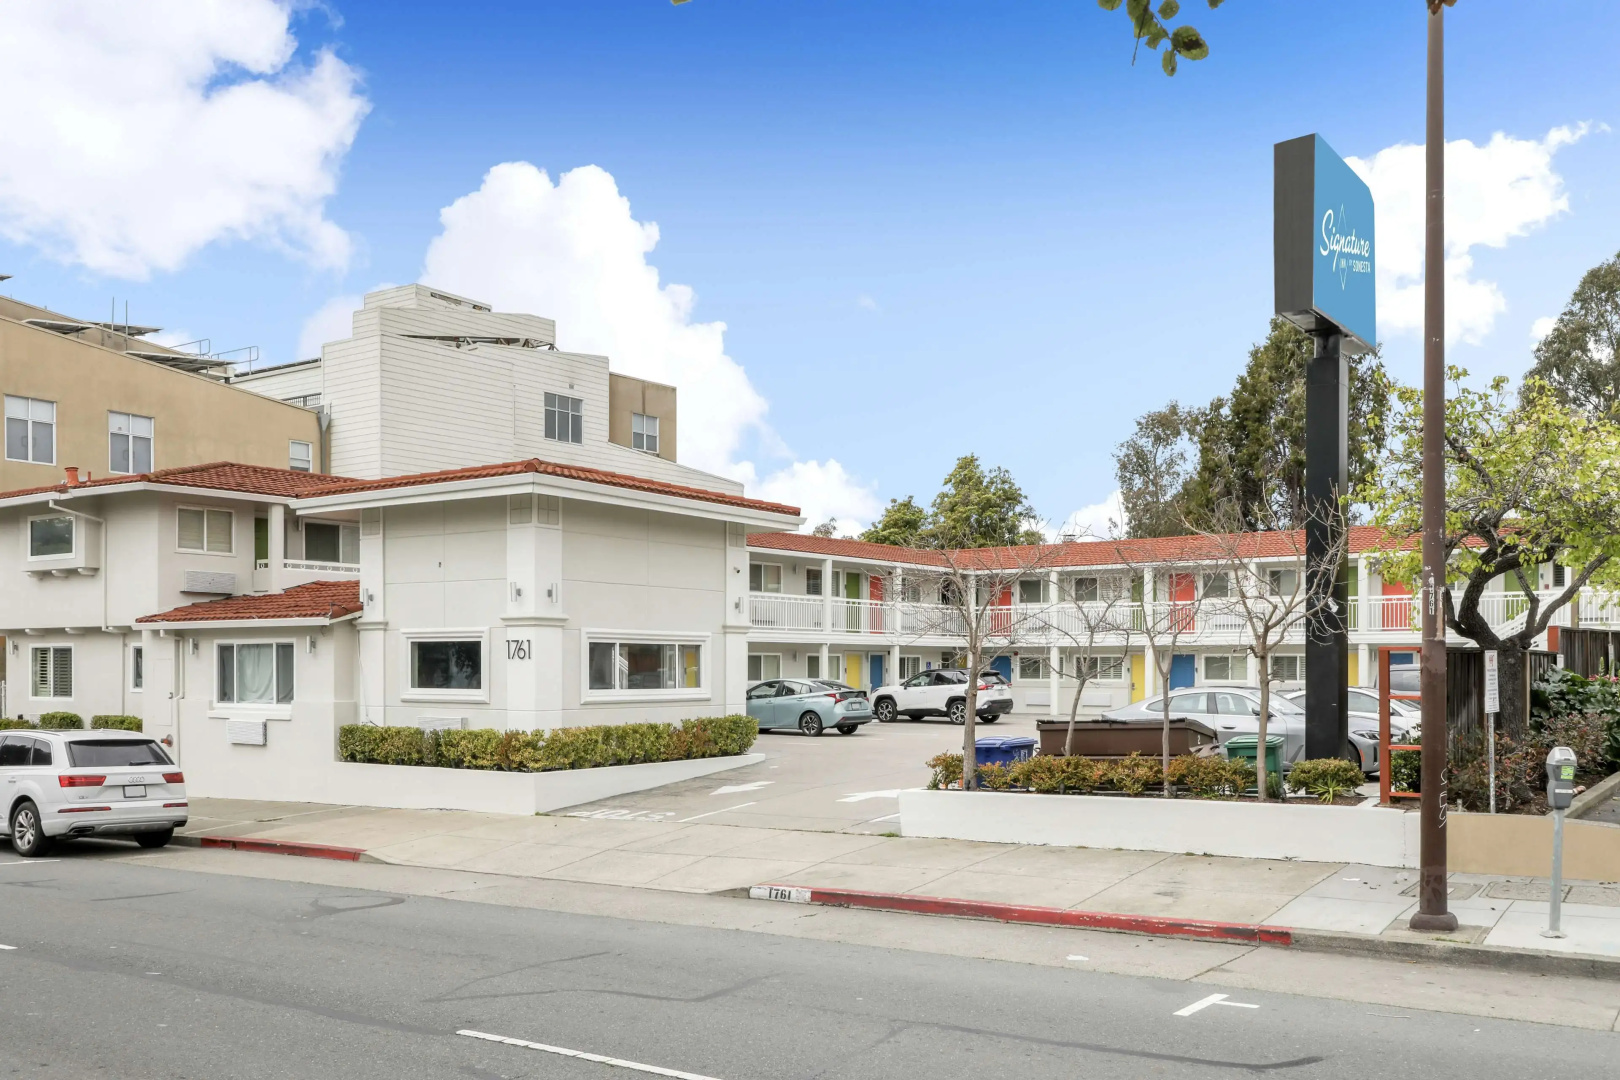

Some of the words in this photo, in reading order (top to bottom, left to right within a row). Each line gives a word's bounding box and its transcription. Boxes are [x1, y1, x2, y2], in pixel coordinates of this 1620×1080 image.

[1320, 209, 1370, 272] Signature
[1353, 260, 1371, 273] SONESTA
[506, 639, 531, 660] 1761
[768, 886, 791, 900] 1761
